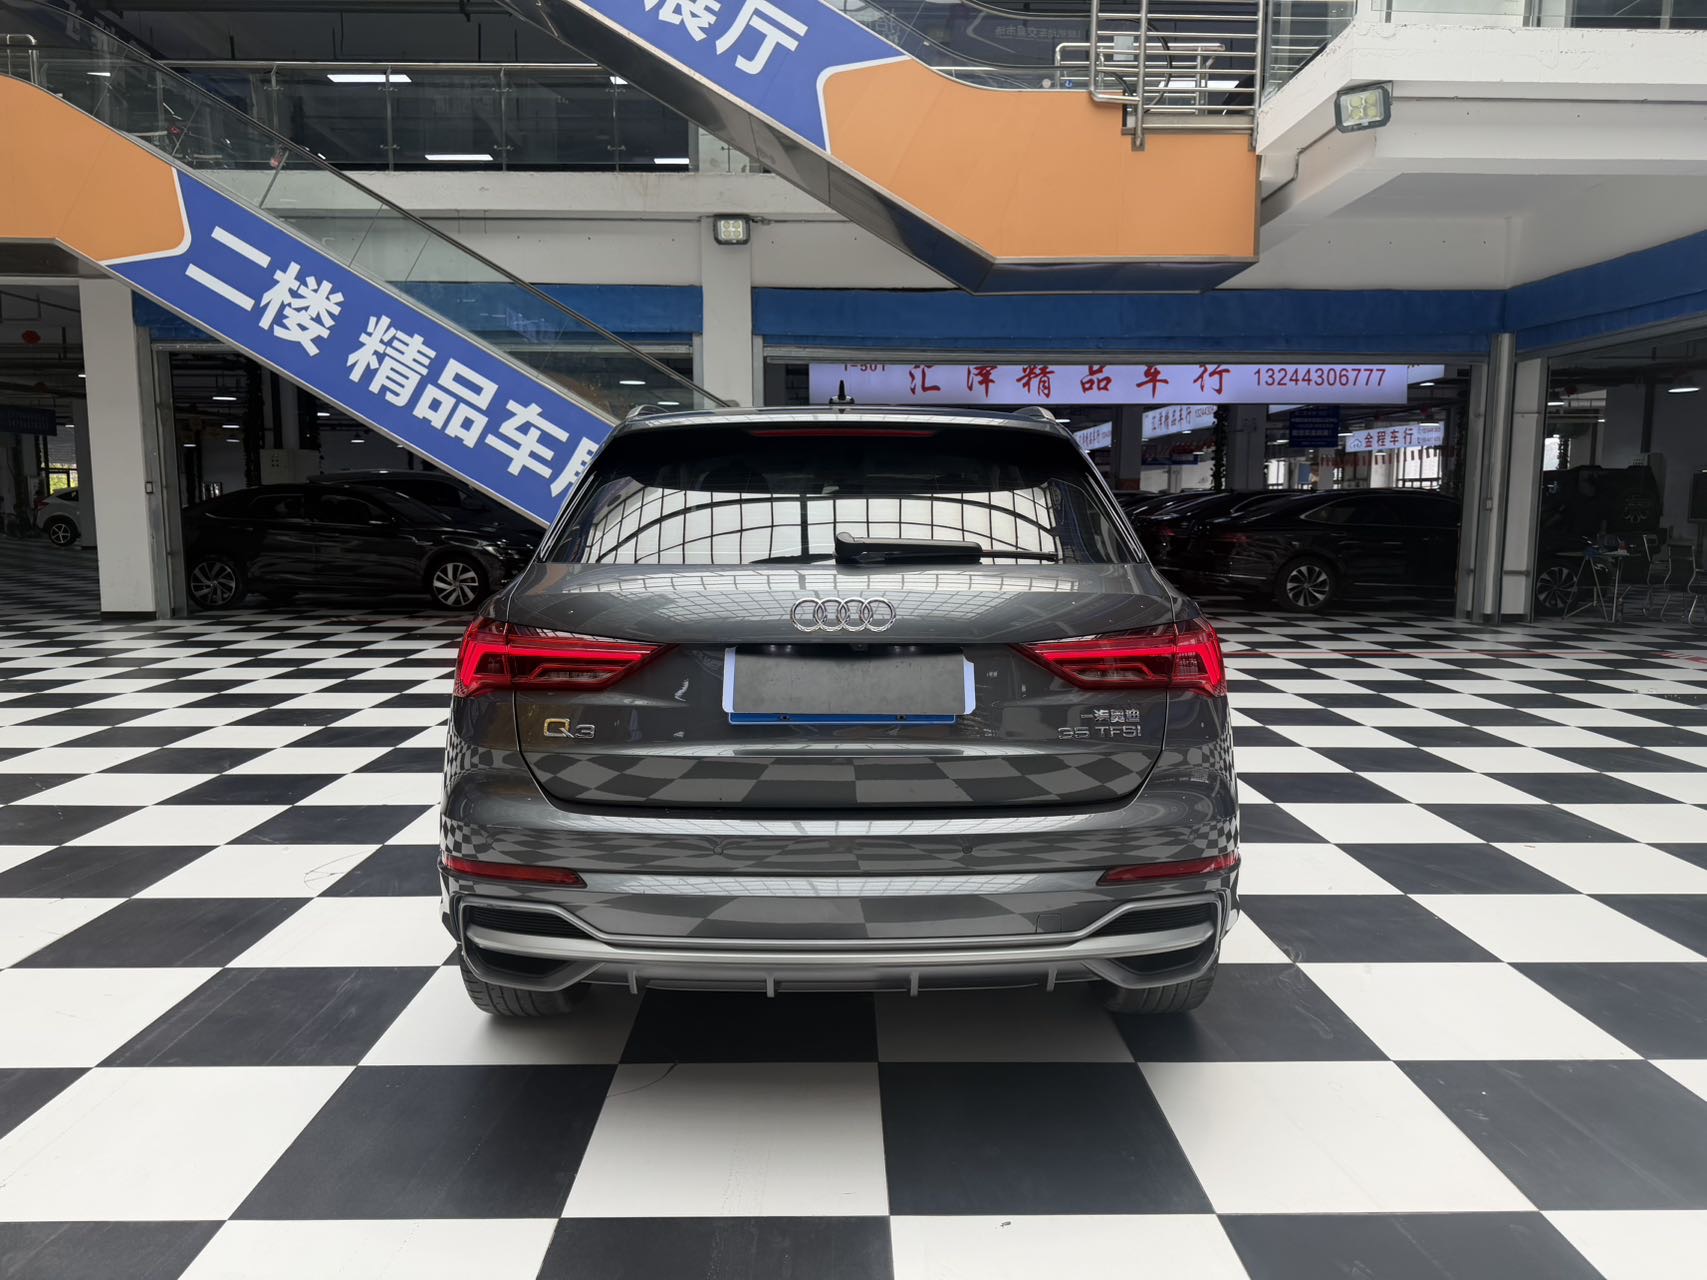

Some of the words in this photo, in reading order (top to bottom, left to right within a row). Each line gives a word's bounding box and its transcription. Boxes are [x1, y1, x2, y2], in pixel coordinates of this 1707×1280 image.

[186, 226, 345, 357] 二楼
[1254, 367, 1387, 387] 13244306777
[543, 718, 596, 739] Q3
